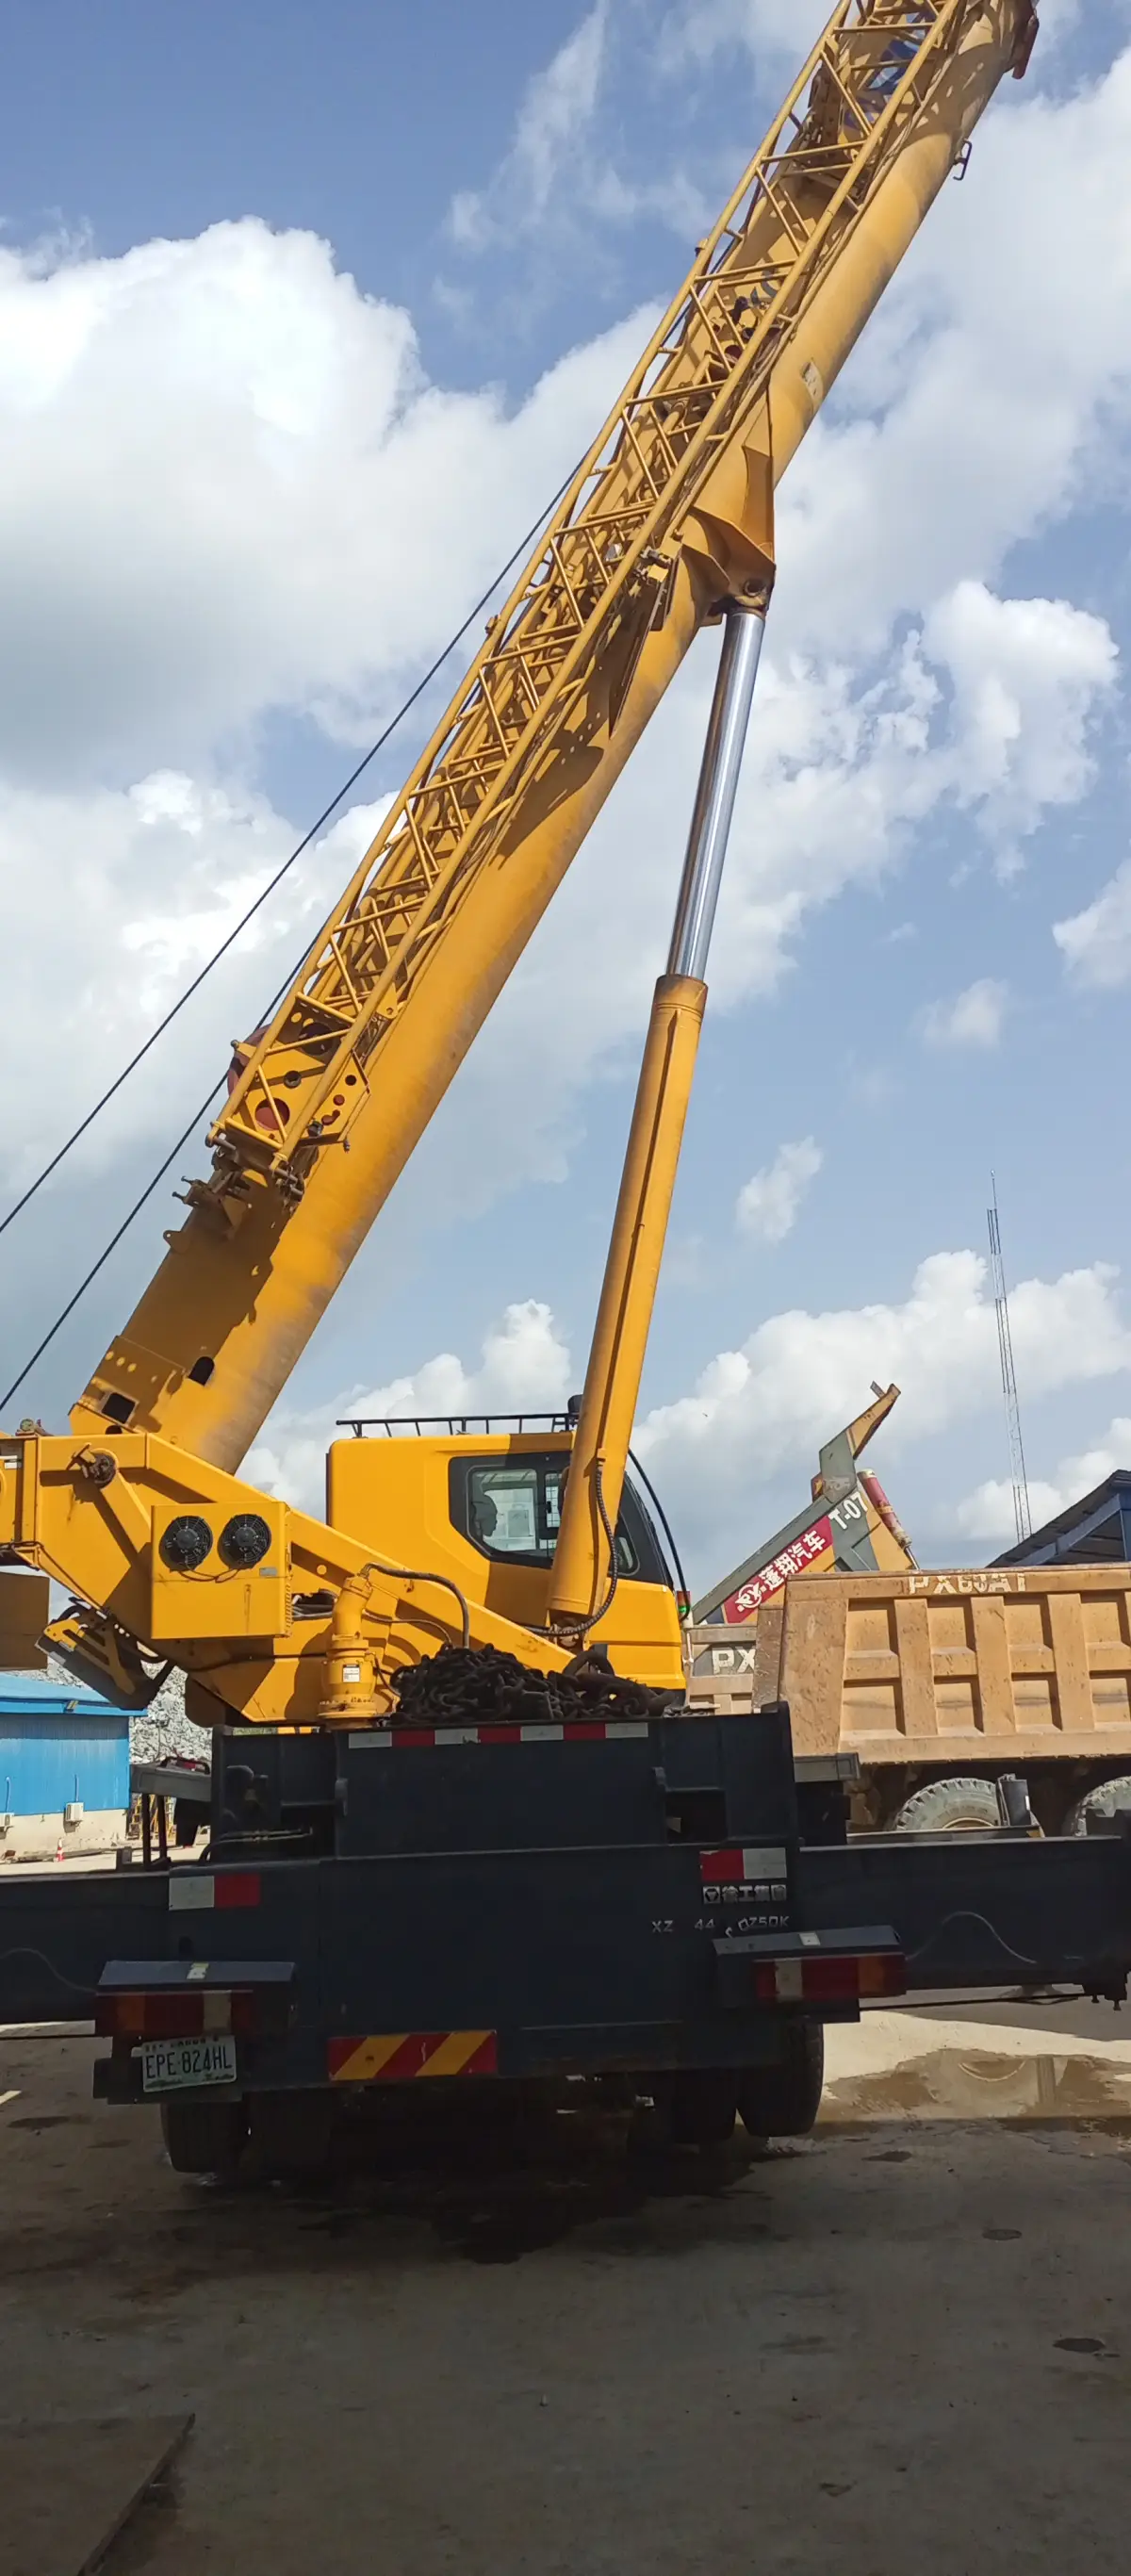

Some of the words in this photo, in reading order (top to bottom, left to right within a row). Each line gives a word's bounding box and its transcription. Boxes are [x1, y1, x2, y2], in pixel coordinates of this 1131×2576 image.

[828, 1491, 868, 1530] T-07
[759, 1530, 826, 1591] 蓬翔汽车
